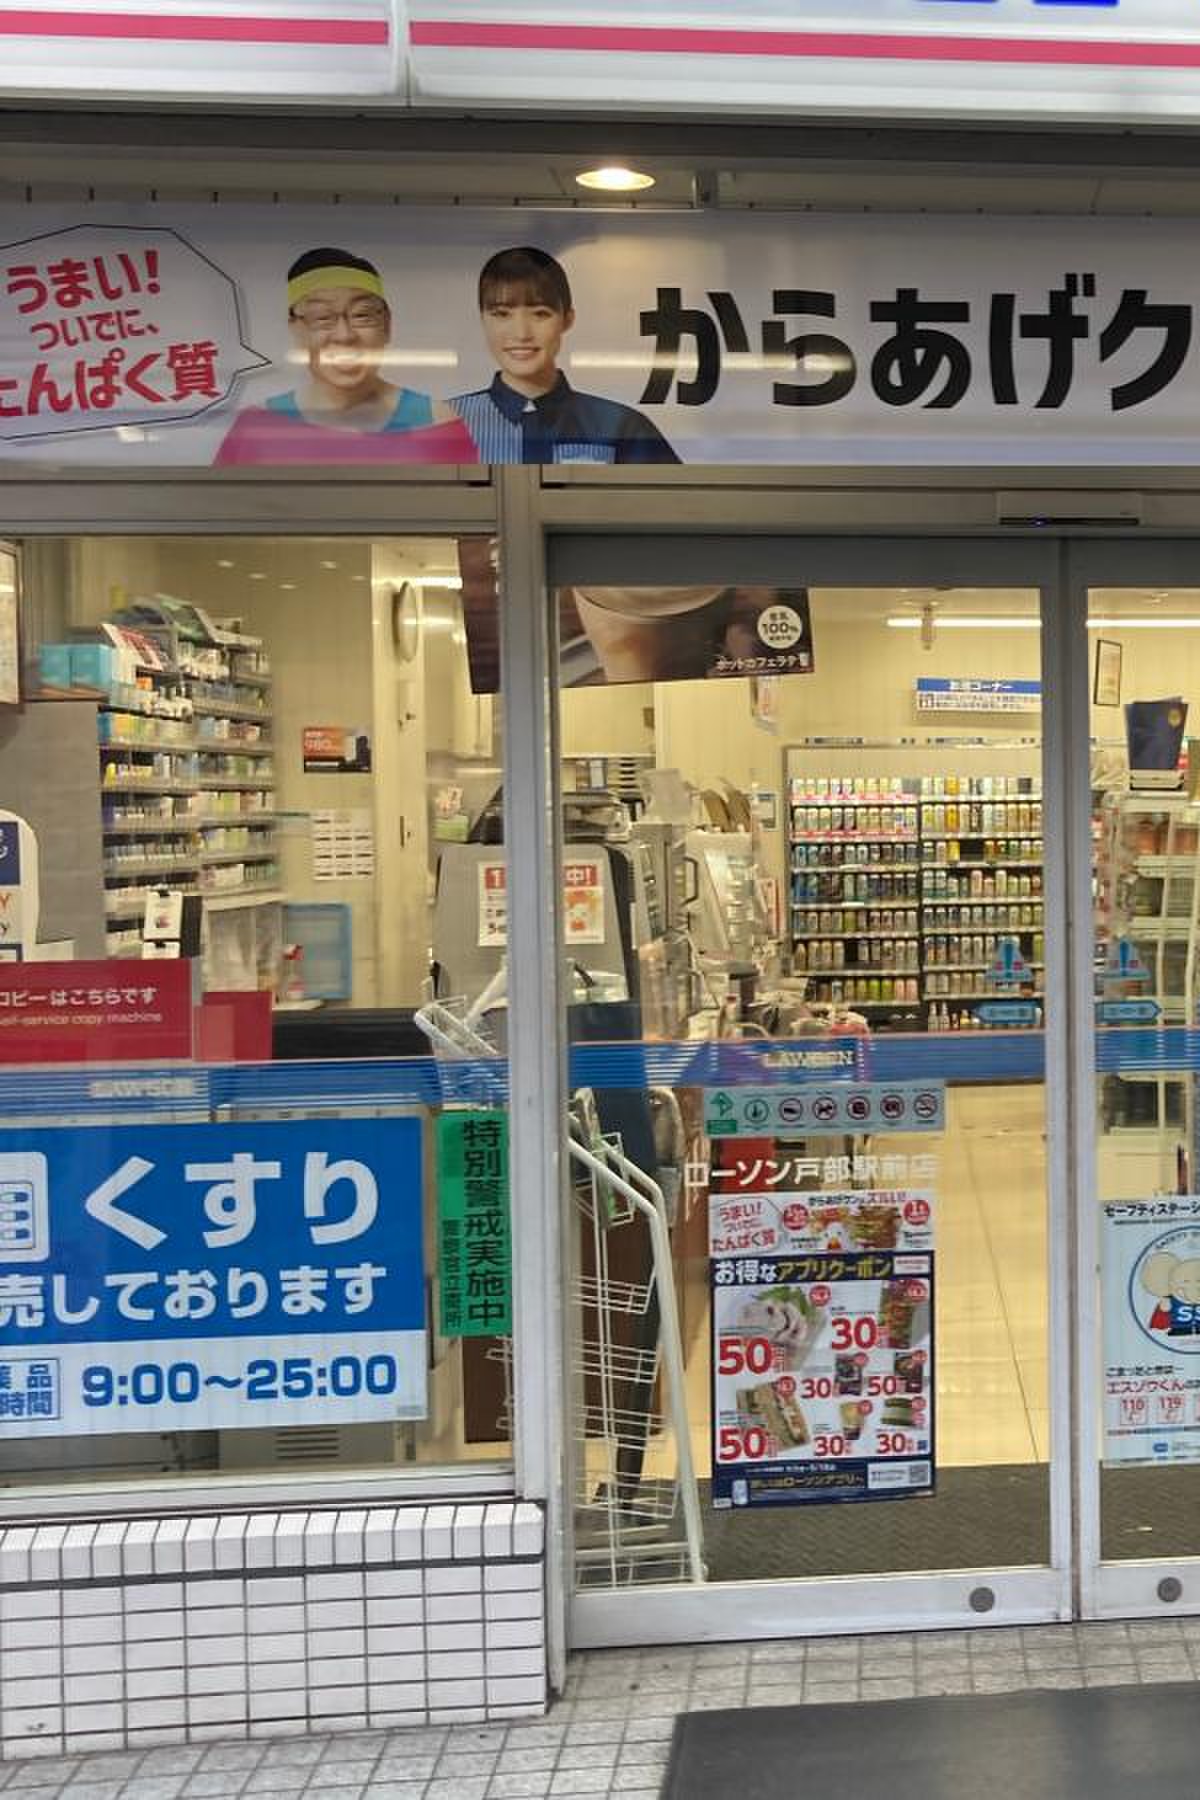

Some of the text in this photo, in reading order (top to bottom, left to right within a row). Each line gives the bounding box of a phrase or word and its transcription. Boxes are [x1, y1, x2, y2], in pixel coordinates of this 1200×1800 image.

[6, 249, 161, 314] うまい!
[30, 309, 160, 350] ついでに、
[0, 1014, 69, 1025] elf-service
[85, 1151, 379, 1250] くすり
[463, 1119, 506, 1328] 特別警戒実施中
[831, 1317, 878, 1351] 30
[718, 1337, 773, 1376] 50
[801, 1377, 832, 1399] 30
[867, 1375, 898, 1397] 50
[718, 1426, 768, 1461] 50
[813, 1435, 845, 1457] 30
[876, 1433, 906, 1454] 30
